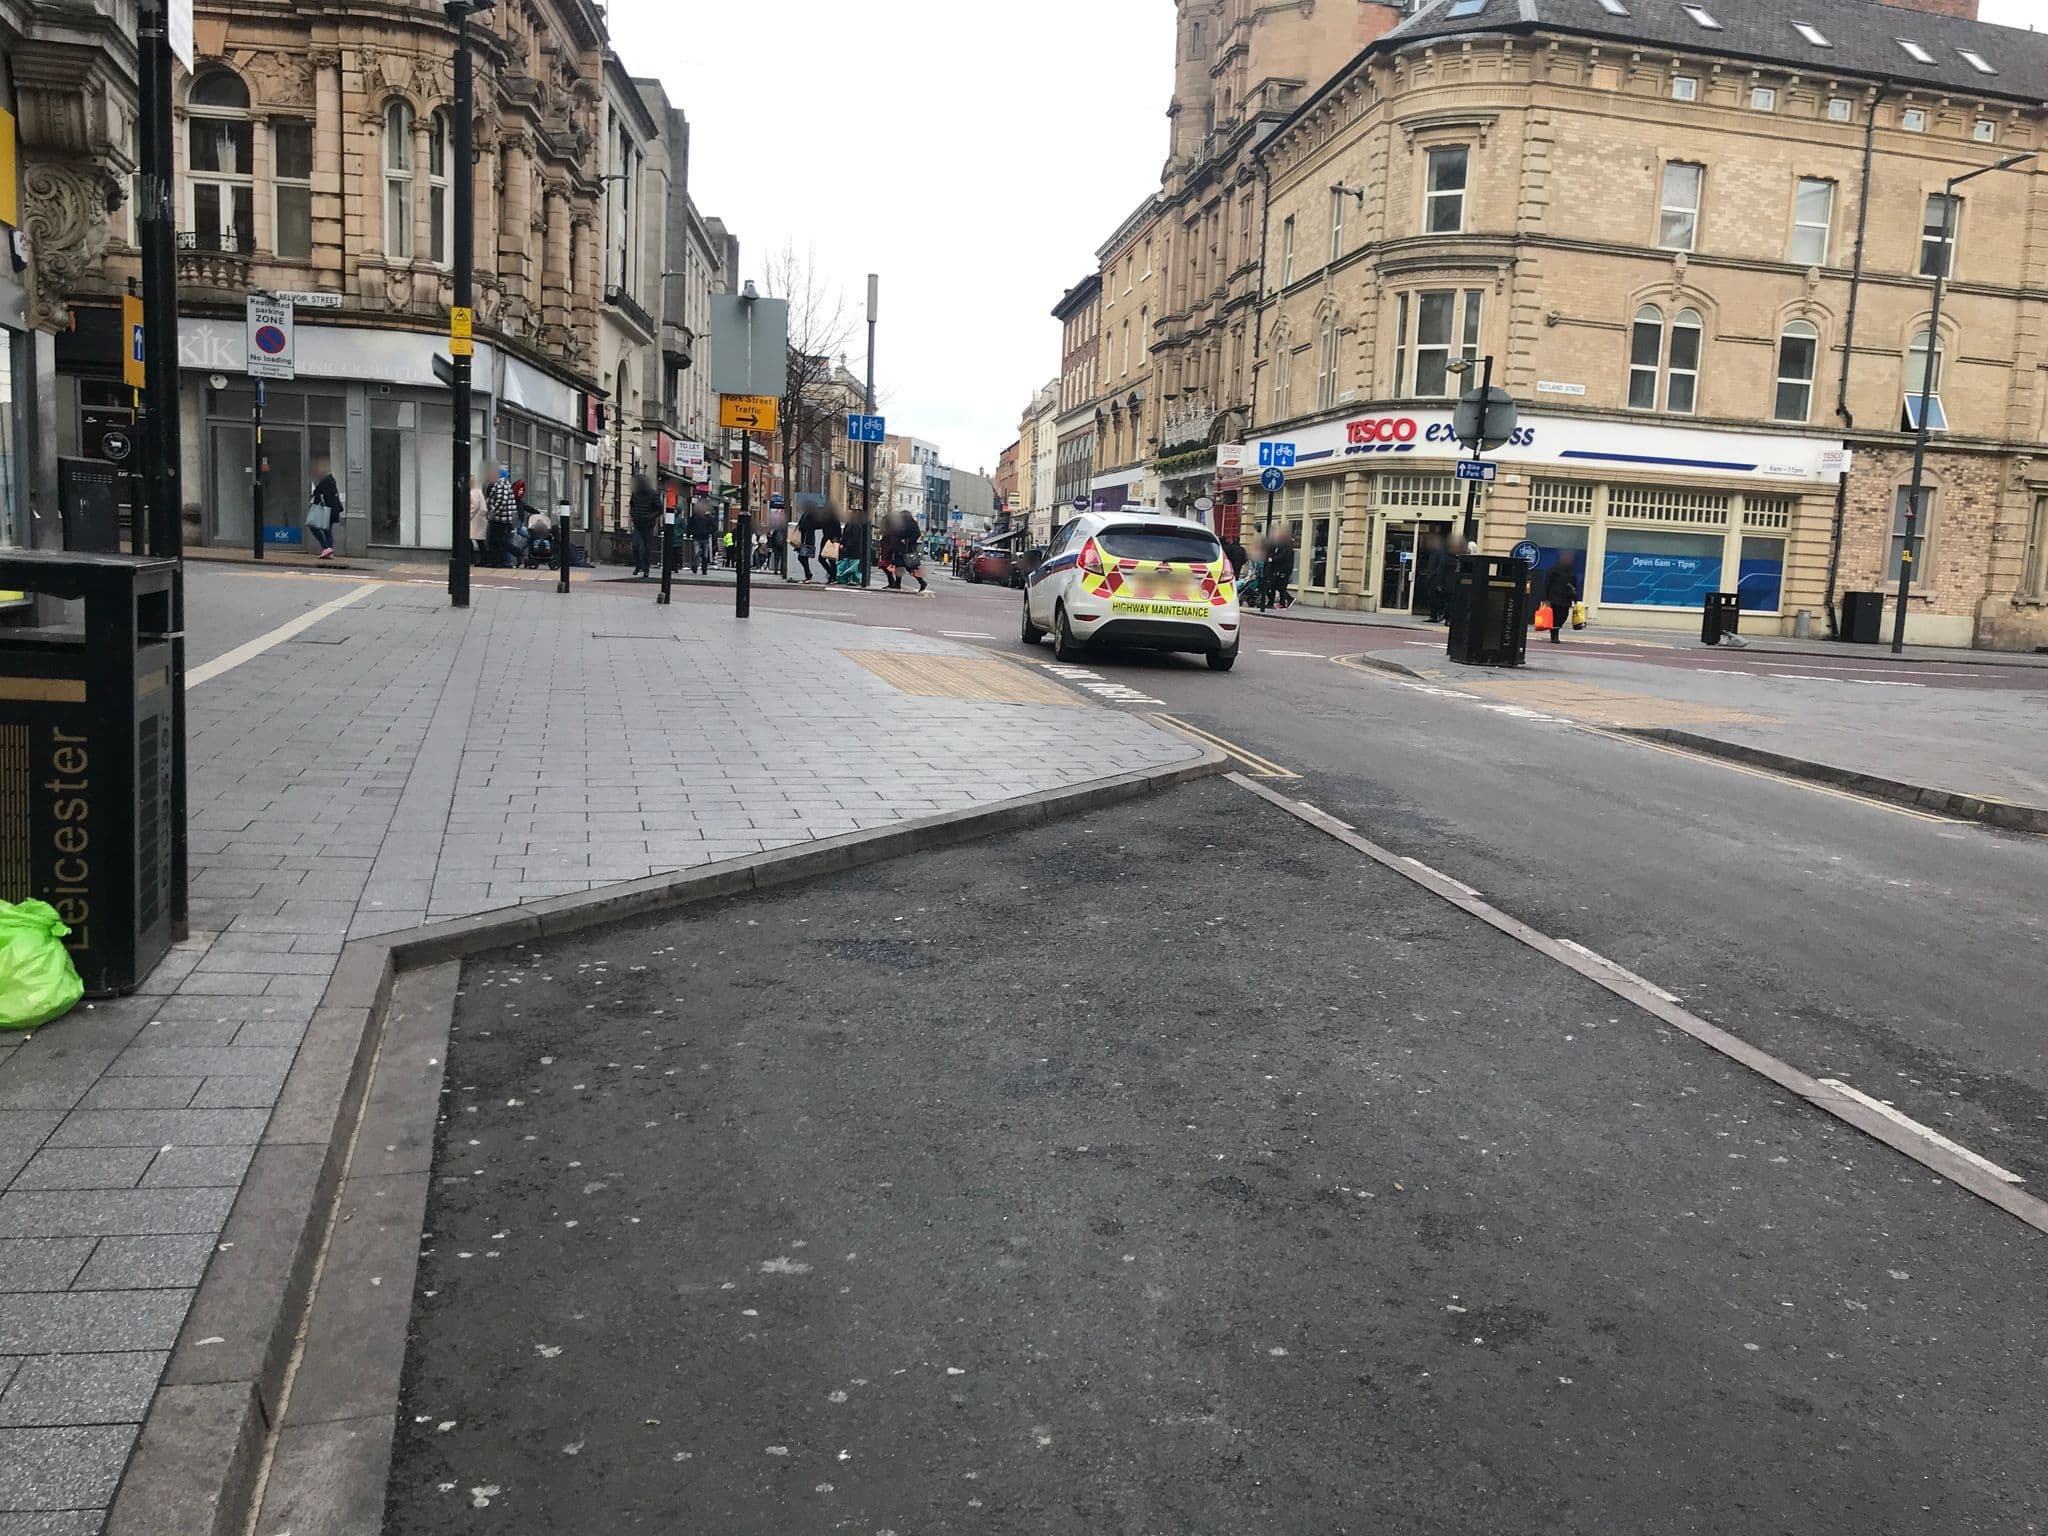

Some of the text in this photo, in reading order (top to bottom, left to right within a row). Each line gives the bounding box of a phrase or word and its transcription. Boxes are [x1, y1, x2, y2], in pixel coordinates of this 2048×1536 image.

[250, 297, 290, 309] Restricted
[279, 293, 340, 305] BELVOIR STREET
[255, 308, 285, 317] parking
[255, 314, 285, 325] ZONE
[250, 353, 262, 362] No
[263, 354, 292, 365] loading
[725, 394, 773, 405] York Street
[734, 404, 762, 415] Traffic
[1346, 418, 1535, 451] TESCO exss
[1632, 557, 1654, 568] Open
[1654, 558, 1671, 567] 6am
[1677, 559, 1696, 570] 11pm
[1112, 602, 1209, 618] HIGHWAY MAINTENANCE
[43, 725, 90, 950] Leicester
